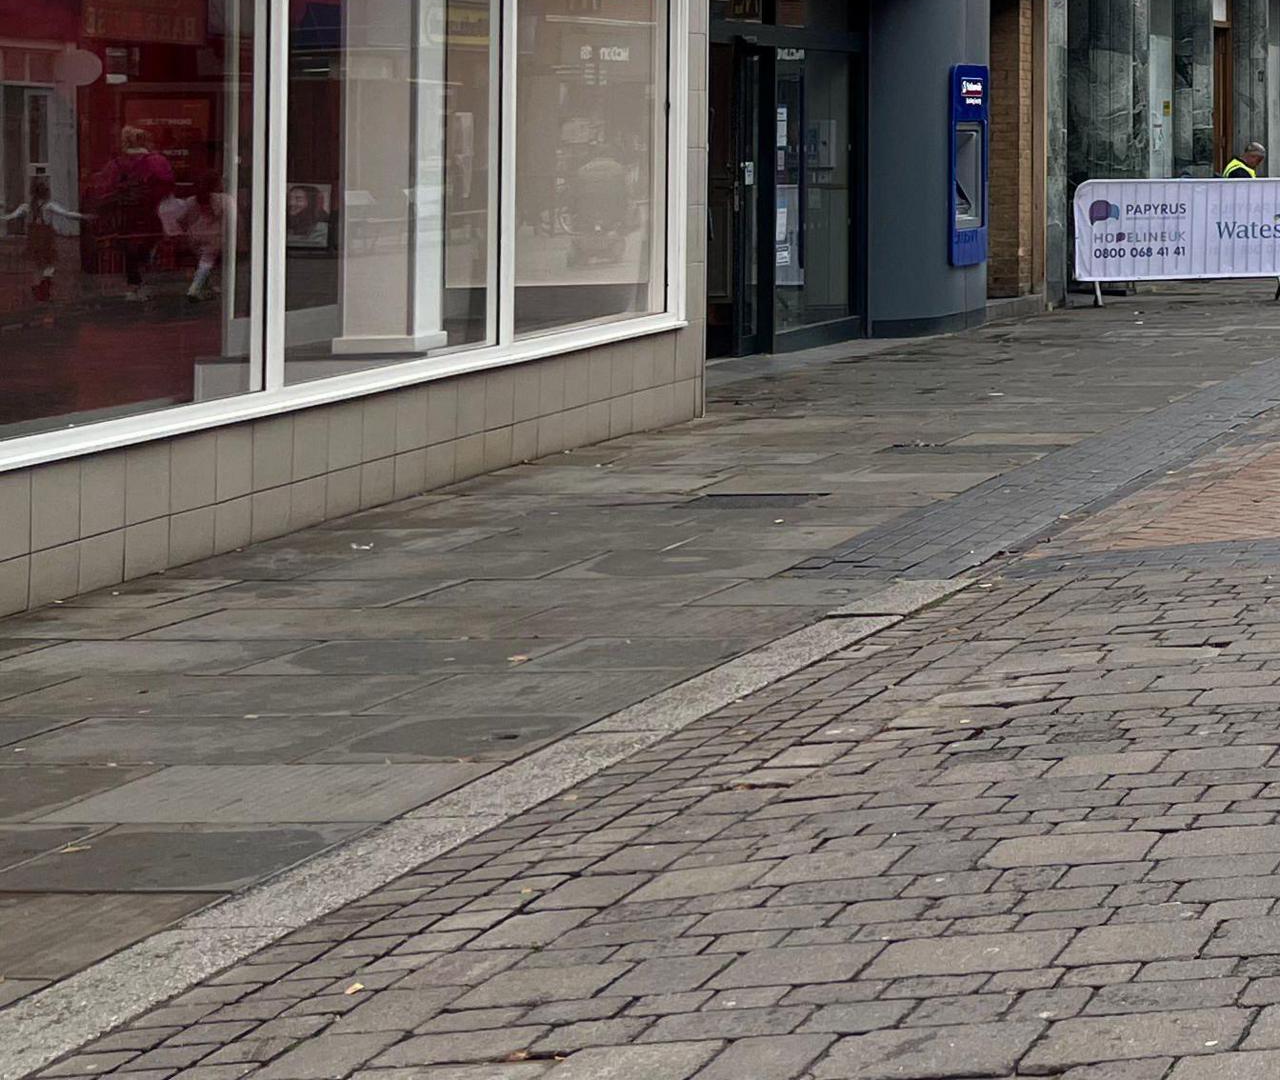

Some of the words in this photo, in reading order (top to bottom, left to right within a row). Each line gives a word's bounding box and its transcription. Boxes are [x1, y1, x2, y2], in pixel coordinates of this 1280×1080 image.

[1126, 203, 1187, 216] PAPYRUS
[1094, 231, 1186, 244] HOPELINEUK
[1094, 248, 1126, 259] 0800
[1130, 247, 1153, 258] 068
[1157, 247, 1169, 257] 41
[1173, 246, 1186, 257] 41
